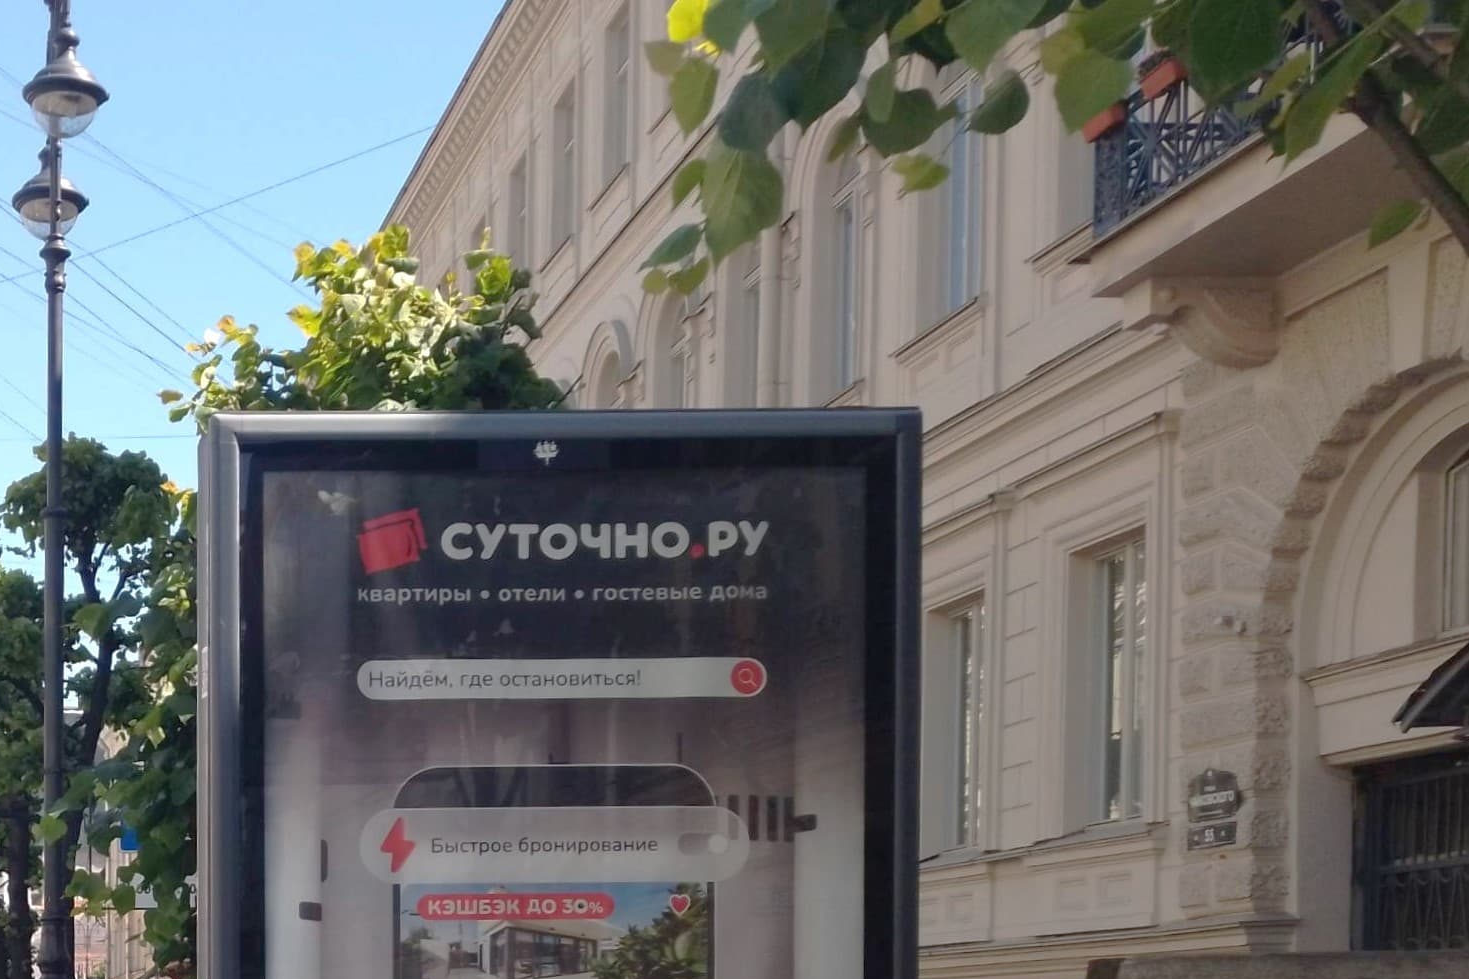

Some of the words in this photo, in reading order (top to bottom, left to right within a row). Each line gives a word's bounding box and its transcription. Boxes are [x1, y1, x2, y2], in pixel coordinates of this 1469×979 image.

[440, 520, 769, 561] СУТОЧНО.РУ
[357, 586, 471, 605] квартиры
[498, 588, 566, 602] отели
[593, 585, 702, 602] гостевые
[710, 583, 768, 602] дома
[369, 670, 453, 690] Найдём,
[460, 673, 493, 689] где
[499, 669, 641, 688] остановиться!
[431, 838, 513, 856] Быстрое
[518, 836, 659, 856] бронирование
[427, 899, 520, 916] КЭШБЭК
[526, 899, 557, 917] ДО
[561, 898, 604, 915] 30%
